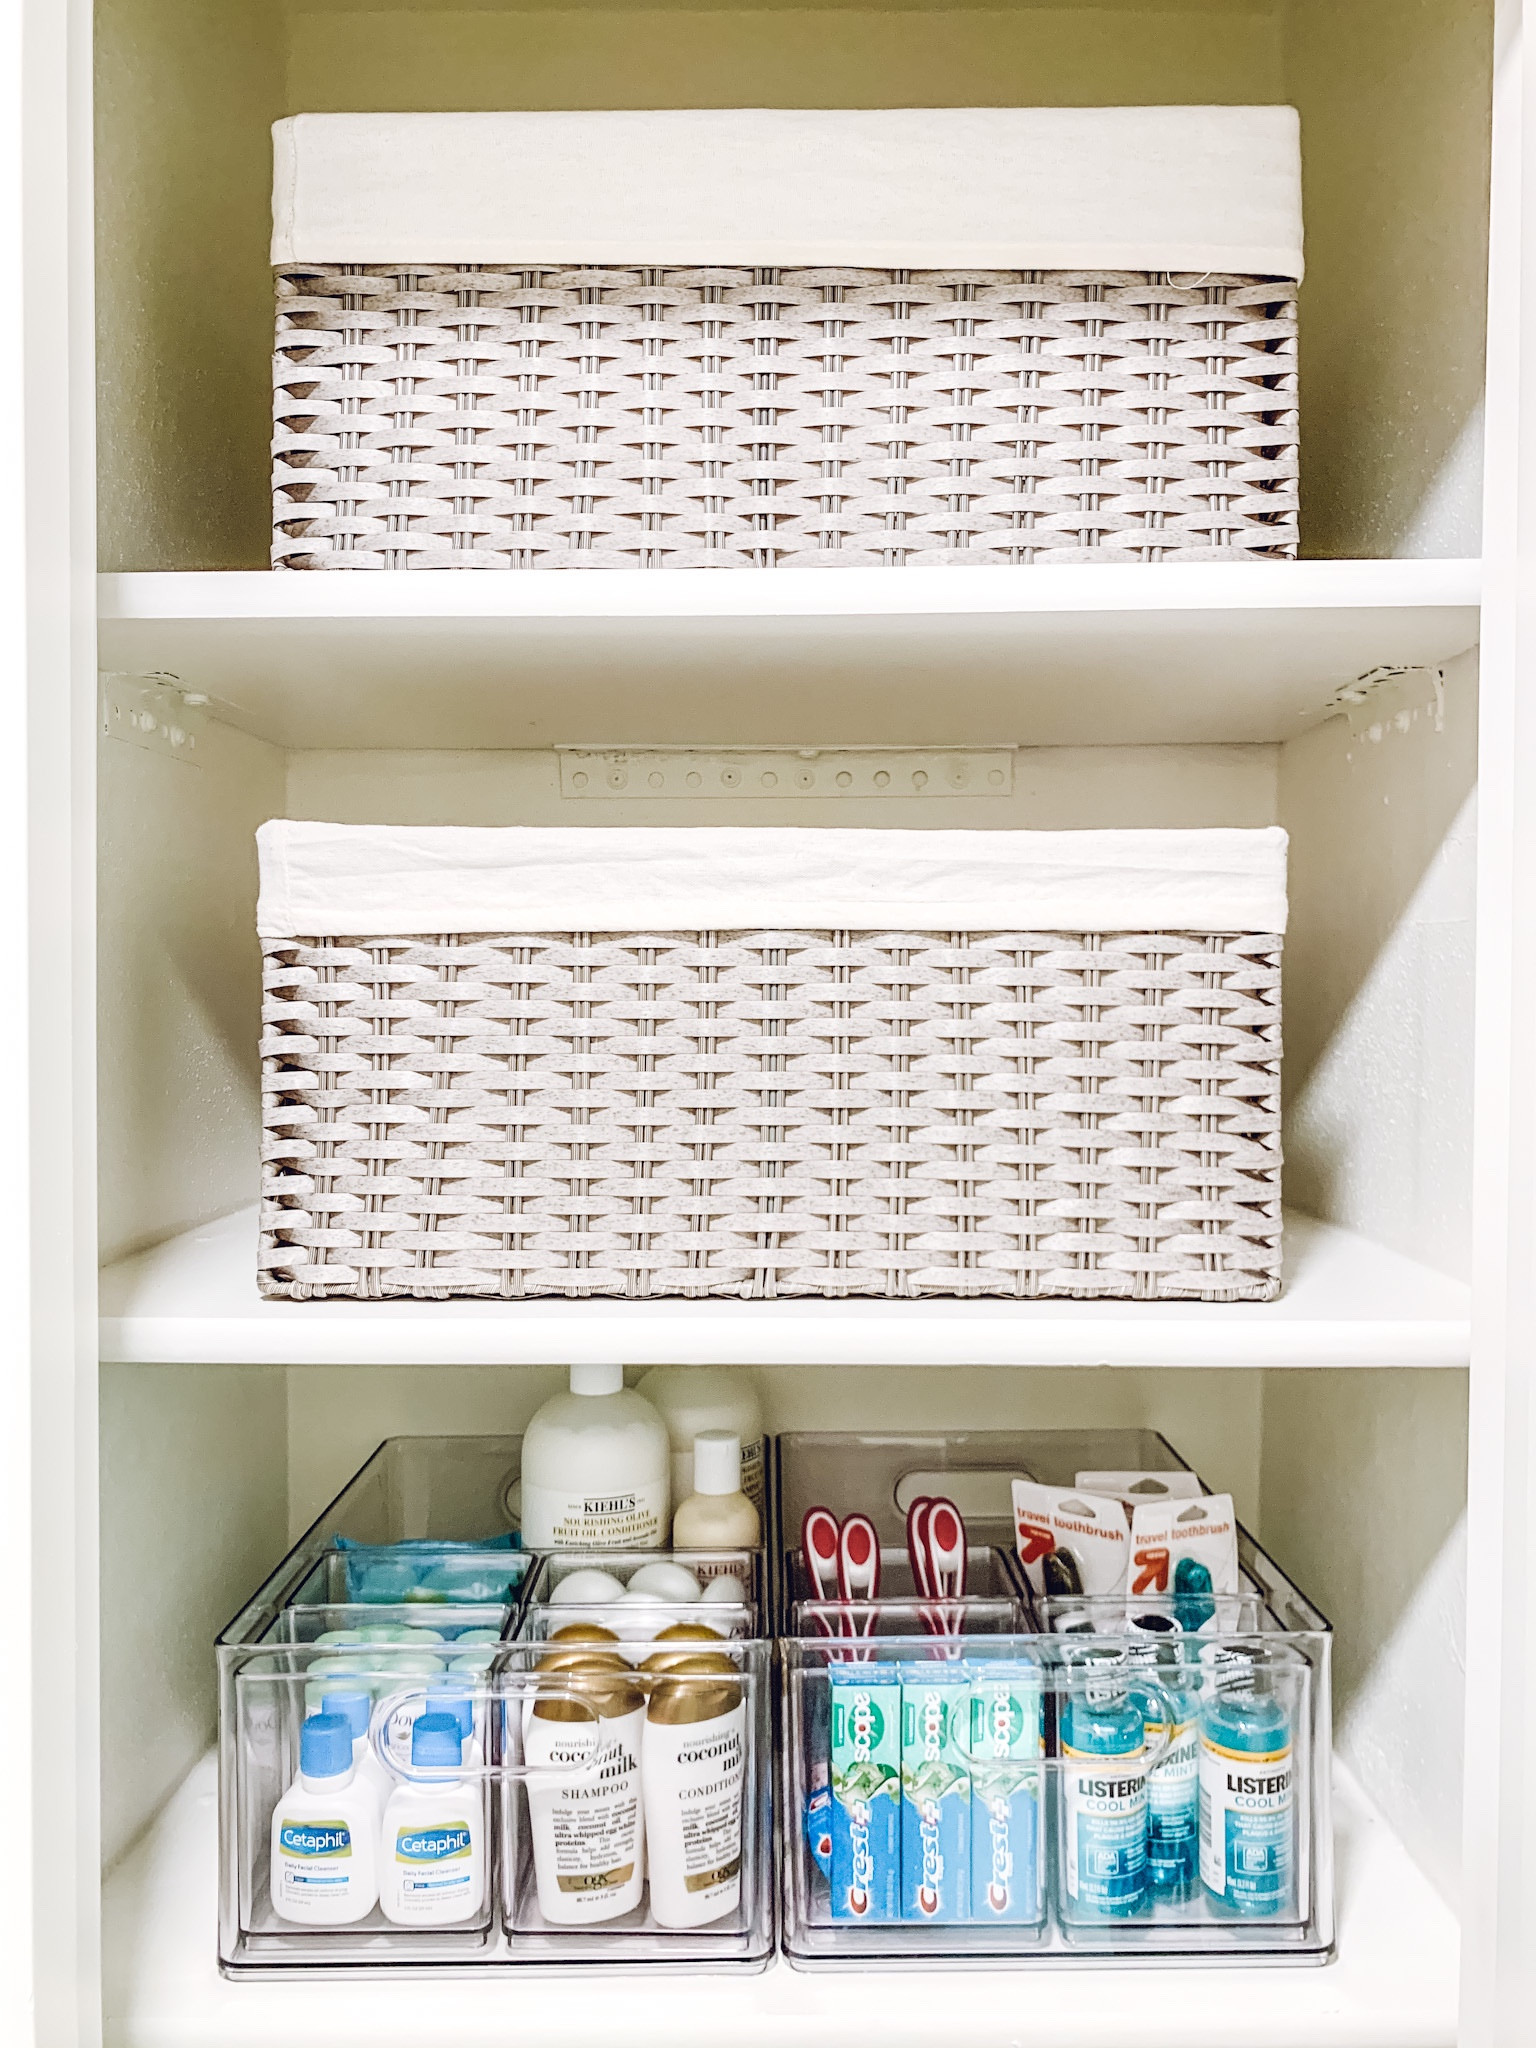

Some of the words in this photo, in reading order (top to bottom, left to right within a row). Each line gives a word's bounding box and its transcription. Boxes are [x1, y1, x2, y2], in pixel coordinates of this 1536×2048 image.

[584, 1496, 636, 1513] KIEHL'S
[553, 1526, 579, 1537] FRUIT
[1017, 1506, 1050, 1525] travel
[1054, 1515, 1124, 1542] toothbrush
[1135, 1530, 1168, 1545] travel
[1171, 1522, 1230, 1540] toothbrush
[600, 1753, 638, 1779] milk
[1164, 1764, 1194, 1778] MINT
[561, 1780, 629, 1800] SHAMPOO
[1227, 1770, 1291, 1795] LISTERI
[1086, 1799, 1125, 1812] COOL
[1235, 1796, 1275, 1808] COOL
[284, 1829, 345, 1851] Cetaphil
[401, 1832, 465, 1855] Cetaphil
[850, 1824, 869, 1914] Crest
[920, 1823, 939, 1914] Crest
[990, 1818, 1009, 1911] Crest
